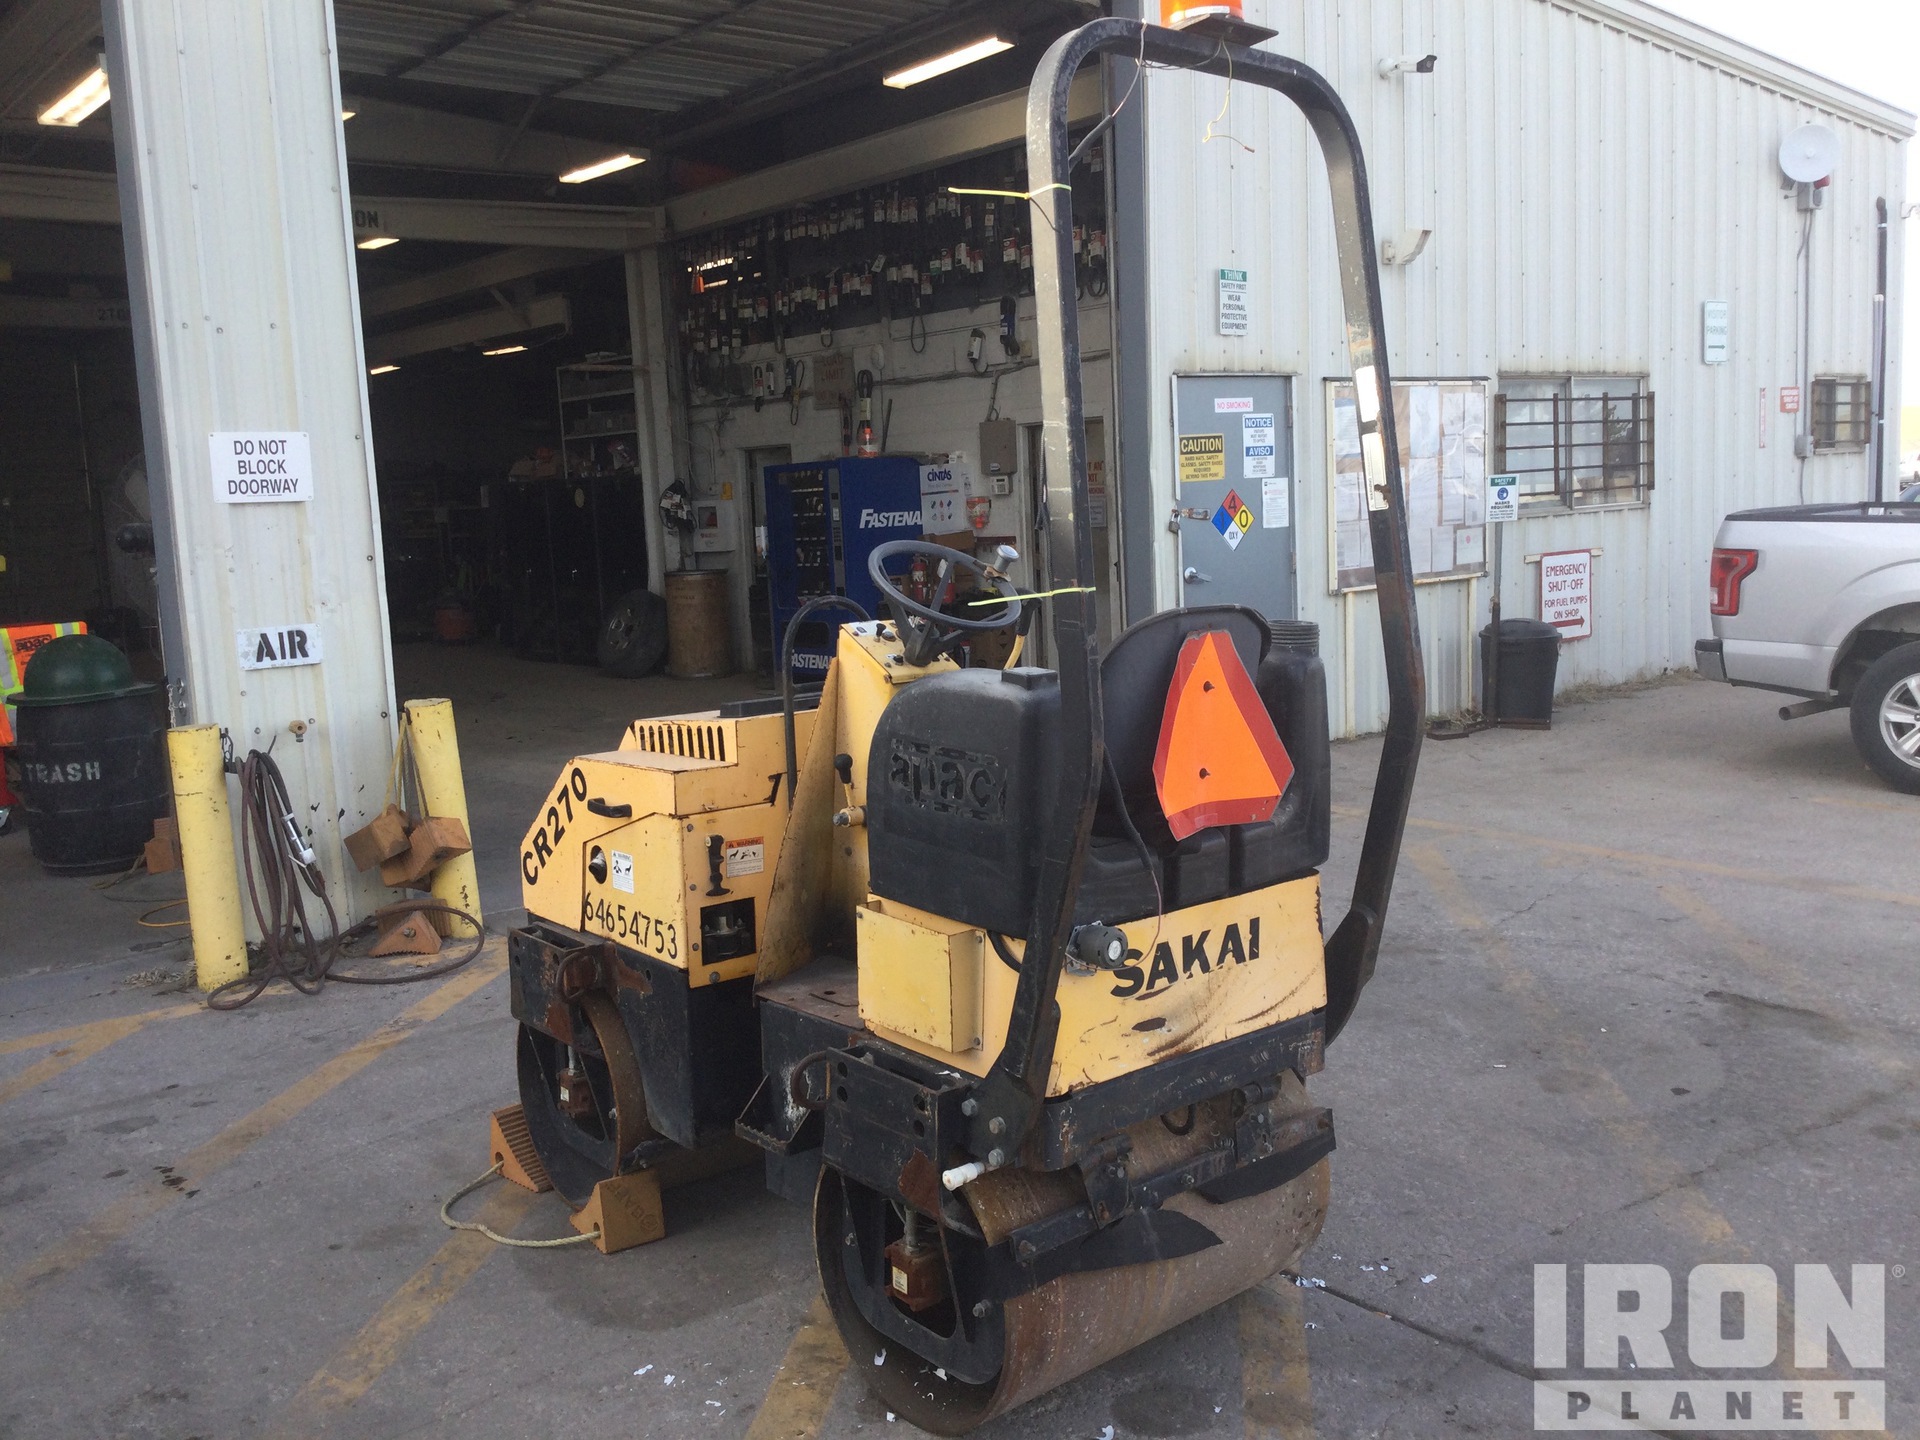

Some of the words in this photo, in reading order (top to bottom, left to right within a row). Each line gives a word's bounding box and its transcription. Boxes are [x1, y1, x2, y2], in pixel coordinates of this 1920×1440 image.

[355, 210, 379, 228] ON
[1224, 270, 1243, 281] THINK
[1223, 303, 1246, 311] PERSONAL
[1221, 313, 1248, 321] PROTECTIVE
[1221, 322, 1248, 330] EQUIPMENT
[1226, 401, 1251, 409] SMOKING
[1245, 418, 1272, 427] NOTICE
[233, 440, 254, 455] DO
[258, 440, 287, 455] NOT
[1181, 438, 1222, 452] CAUTION
[1248, 447, 1271, 455] AVISO
[237, 459, 287, 475] BLOCK
[927, 468, 952, 481] CINTAS
[227, 478, 299, 495] DOORWAY
[1228, 495, 1237, 512] 4
[859, 509, 923, 528] FASTENA
[1239, 509, 1248, 528] 0
[1228, 531, 1238, 540] OXY
[1545, 563, 1587, 577] EMERGENCY
[1548, 578, 1584, 593] SHUT-OFF
[1544, 600, 1555, 608] FOR
[1556, 598, 1568, 607] FUEL
[1570, 595, 1588, 605] PUMPS
[1553, 611, 1563, 620] ON
[1564, 608, 1579, 618] SHOP
[256, 630, 309, 662] AIR
[791, 649, 832, 669] ASTENA
[25, 761, 100, 784] TRASH
[522, 767, 587, 886] CR270
[1110, 916, 1260, 998] SAKAI
